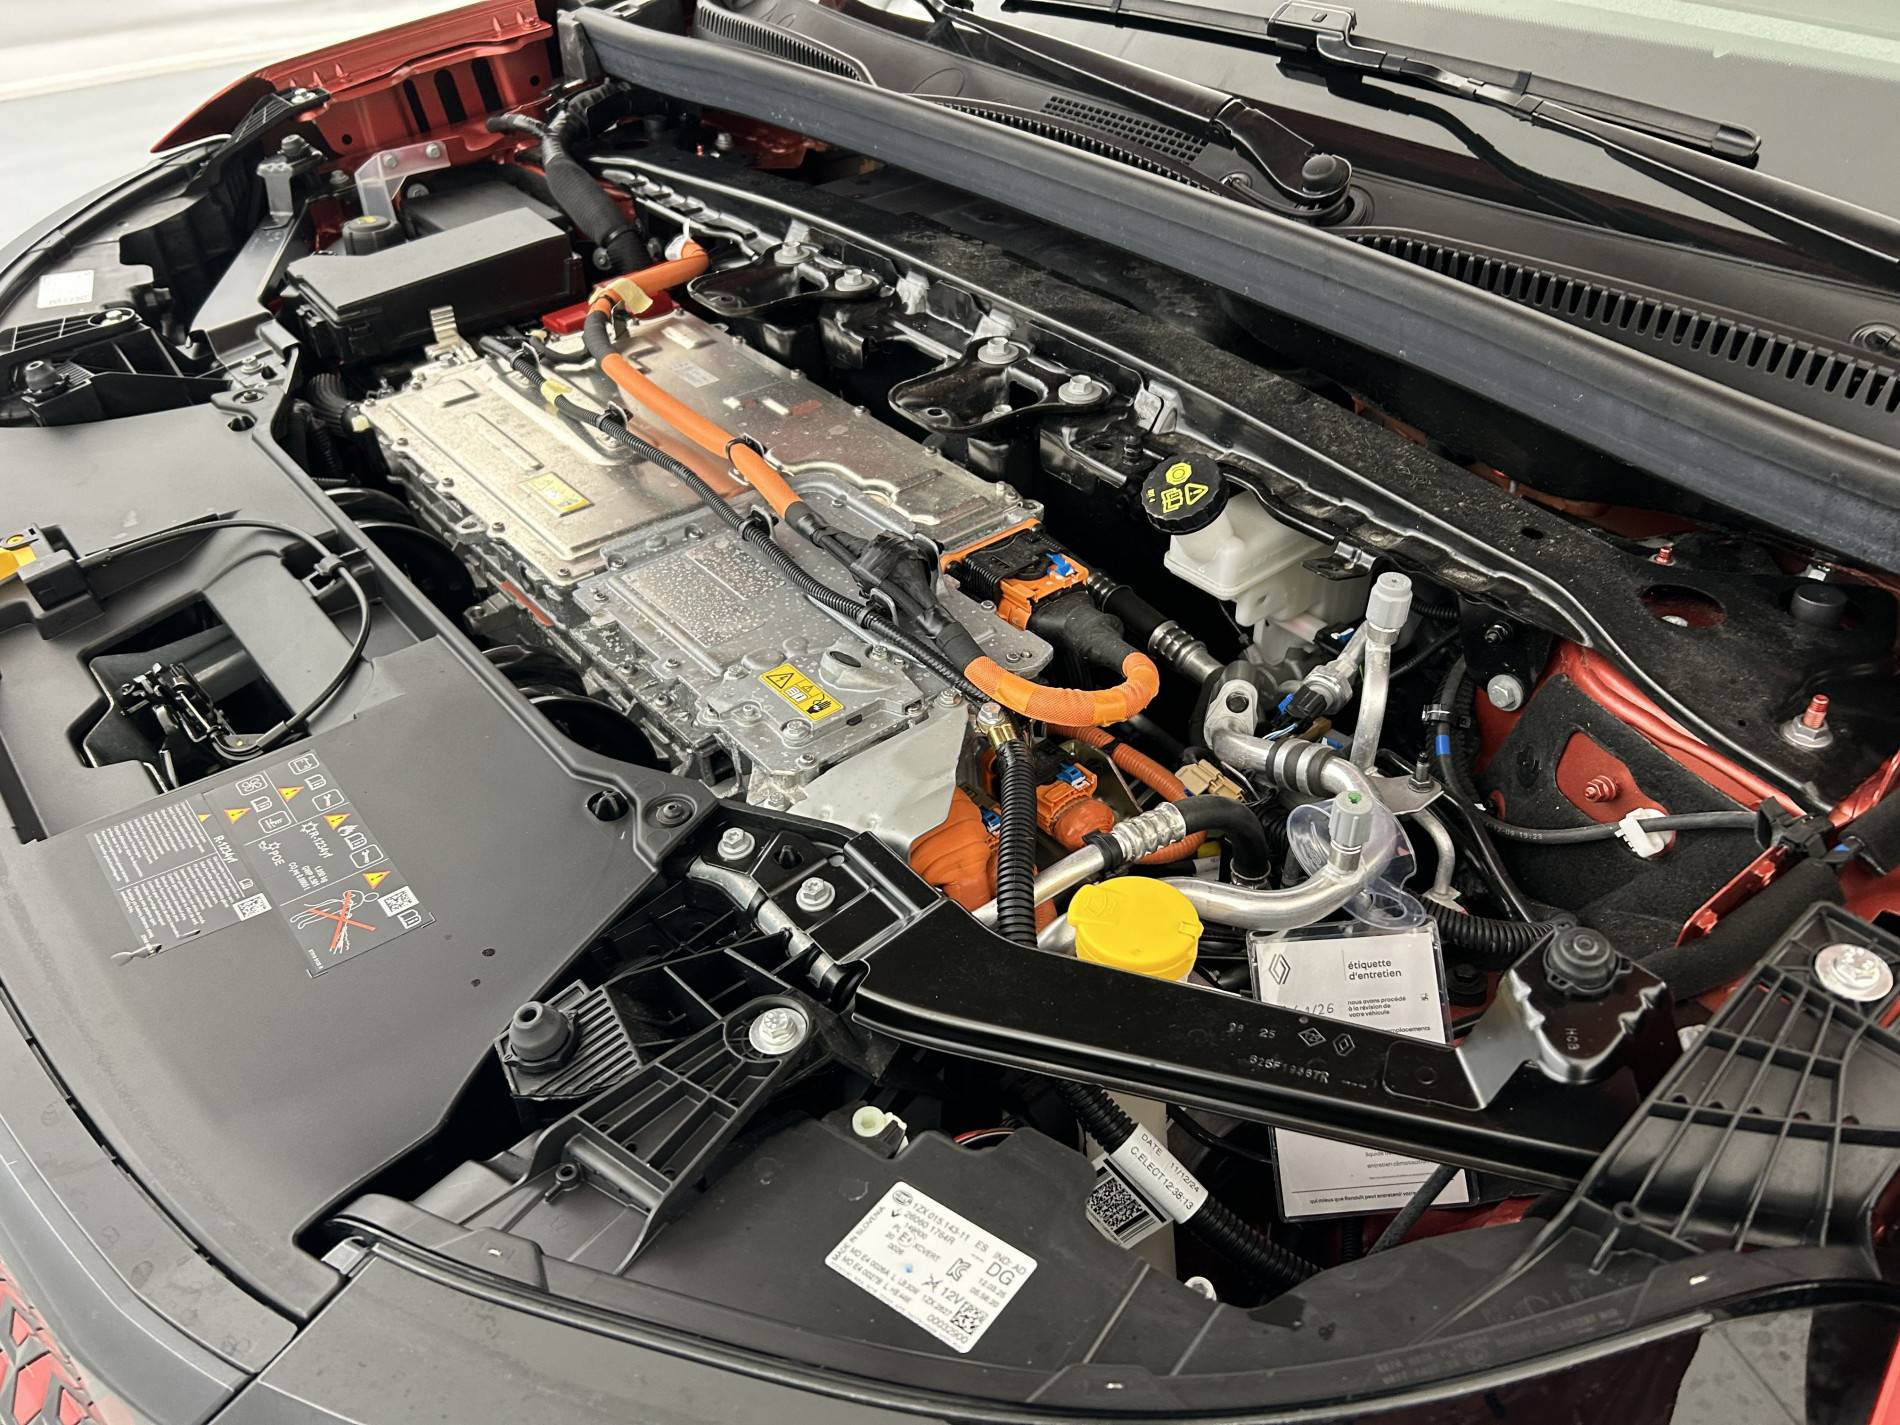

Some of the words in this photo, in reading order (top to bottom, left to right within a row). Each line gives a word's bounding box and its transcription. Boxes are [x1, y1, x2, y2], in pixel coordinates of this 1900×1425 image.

[268, 849, 286, 867] POE
[1347, 959, 1392, 970] étiquette
[1349, 969, 1402, 980] d'entretien
[1260, 1027, 1276, 1038] 25
[1141, 1132, 1163, 1157] DATE
[1169, 1162, 1200, 1193] 11/12/24
[1130, 1145, 1164, 1180] C.ELECT
[1163, 1178, 1195, 1211] 12:38:13
[984, 1261, 1016, 1285] DG
[939, 1286, 965, 1306] 12V
